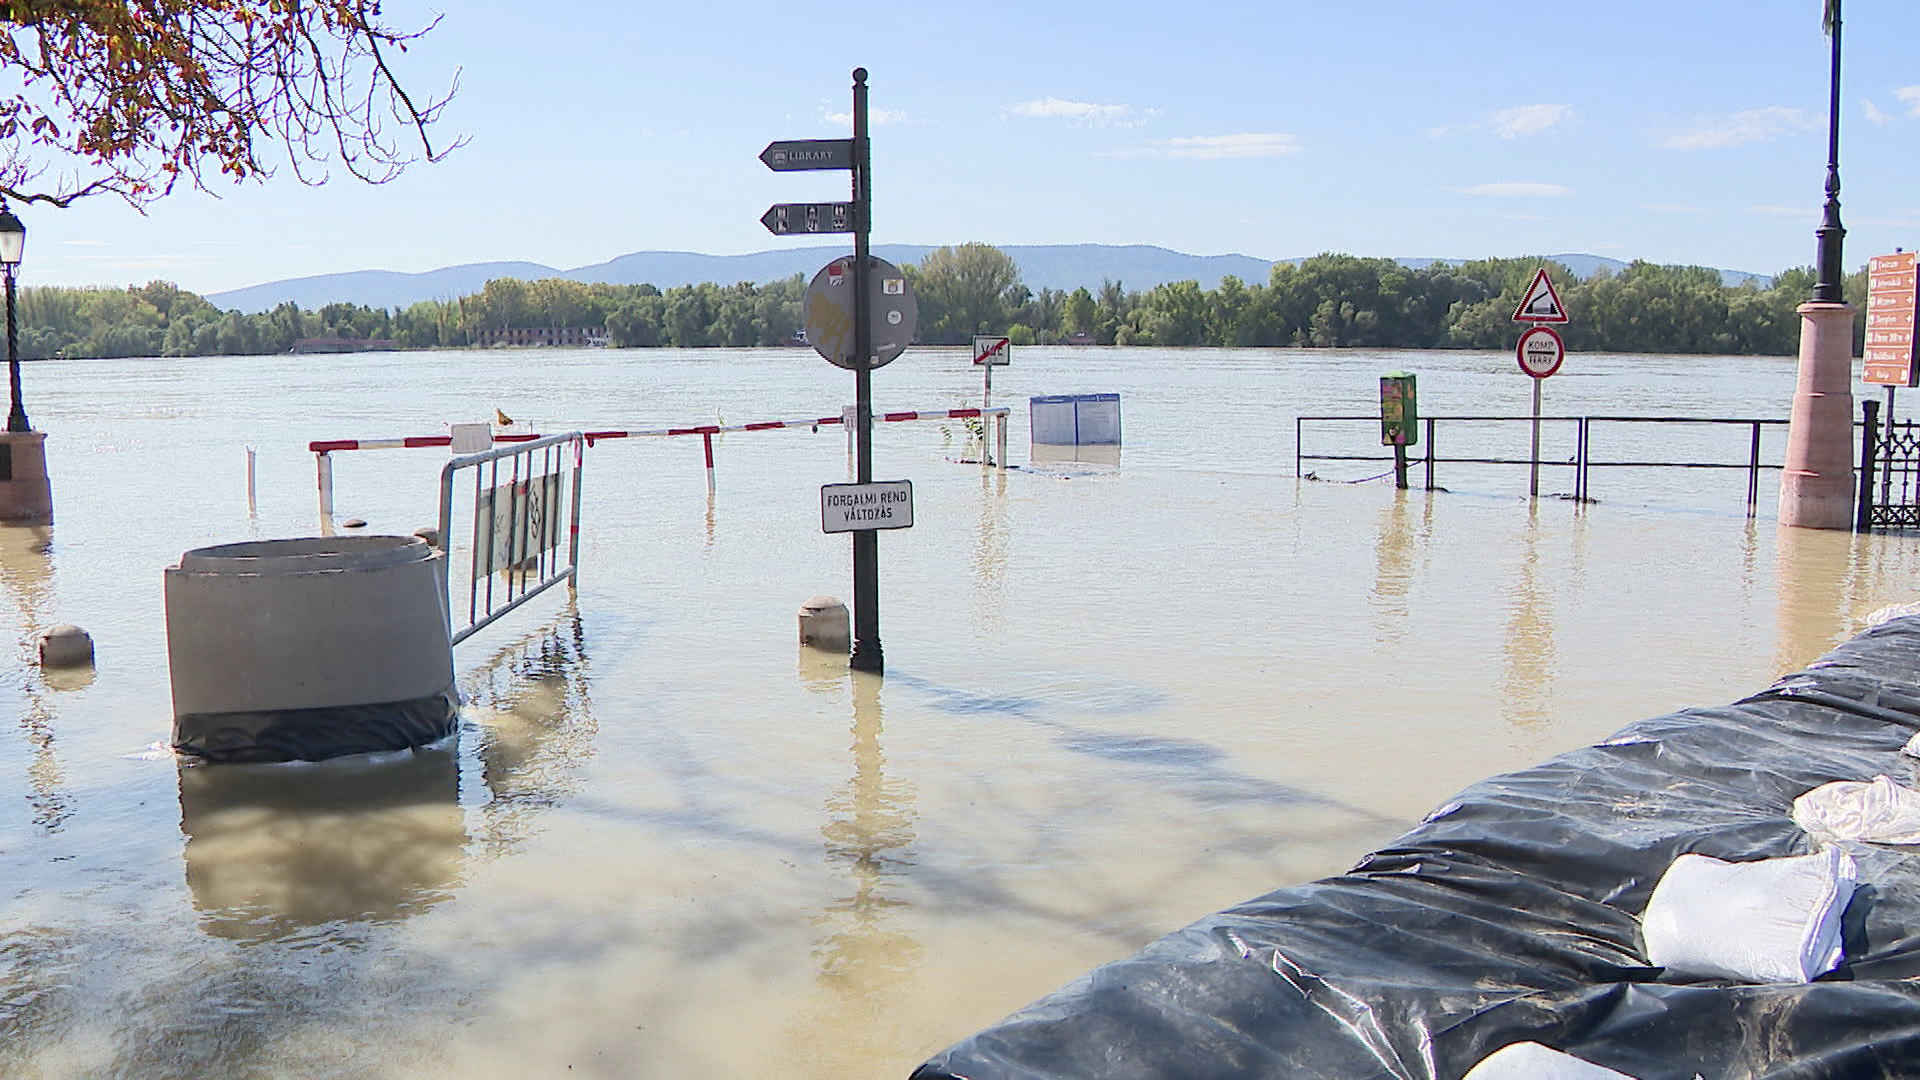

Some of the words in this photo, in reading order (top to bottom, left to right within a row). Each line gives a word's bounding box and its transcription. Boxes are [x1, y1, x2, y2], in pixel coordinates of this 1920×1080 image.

[789, 151, 833, 161] LIBRARY
[1527, 340, 1554, 350] KOMP
[1529, 355, 1553, 364] FERRY
[827, 493, 877, 506] FORGALMI
[880, 491, 907, 503] REND
[844, 505, 893, 522] VÁLTOZÁS
